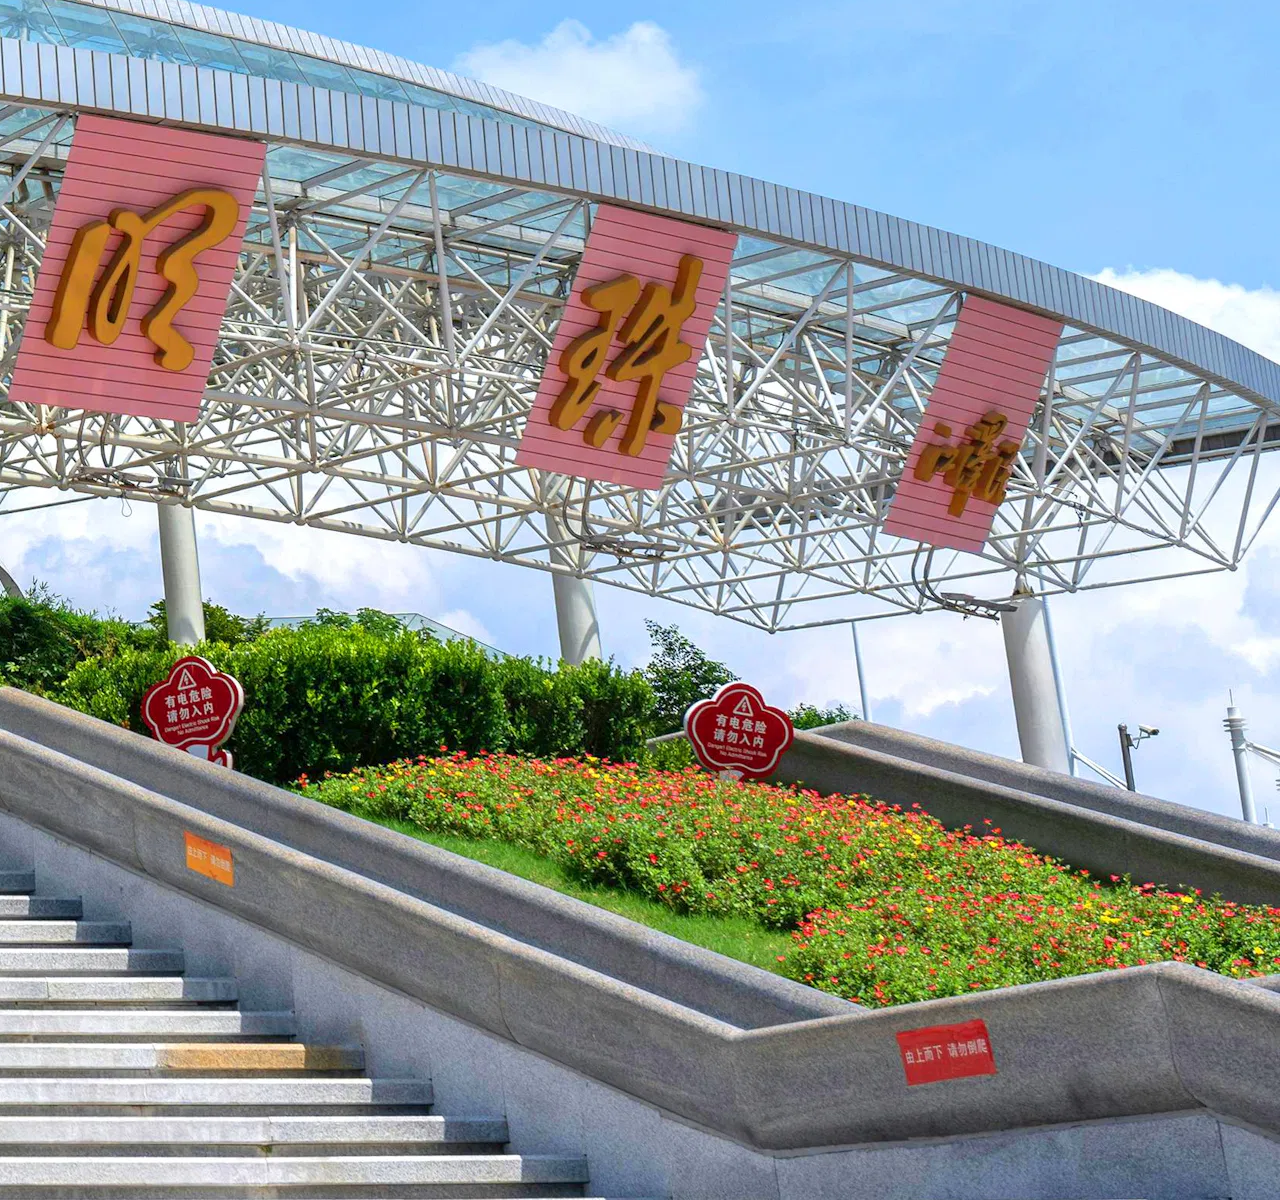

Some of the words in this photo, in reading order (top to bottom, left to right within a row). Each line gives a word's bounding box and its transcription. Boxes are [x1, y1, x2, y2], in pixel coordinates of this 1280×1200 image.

[45, 189, 240, 373] 明
[549, 254, 703, 457] 珠
[164, 686, 213, 709] 有电危险
[166, 702, 215, 723] 请勿入内
[715, 713, 768, 735] 有电危险
[713, 728, 765, 749] 请勿入内
[905, 1044, 943, 1064] 由上而下
[947, 1038, 988, 1058] 请勿倒爬
